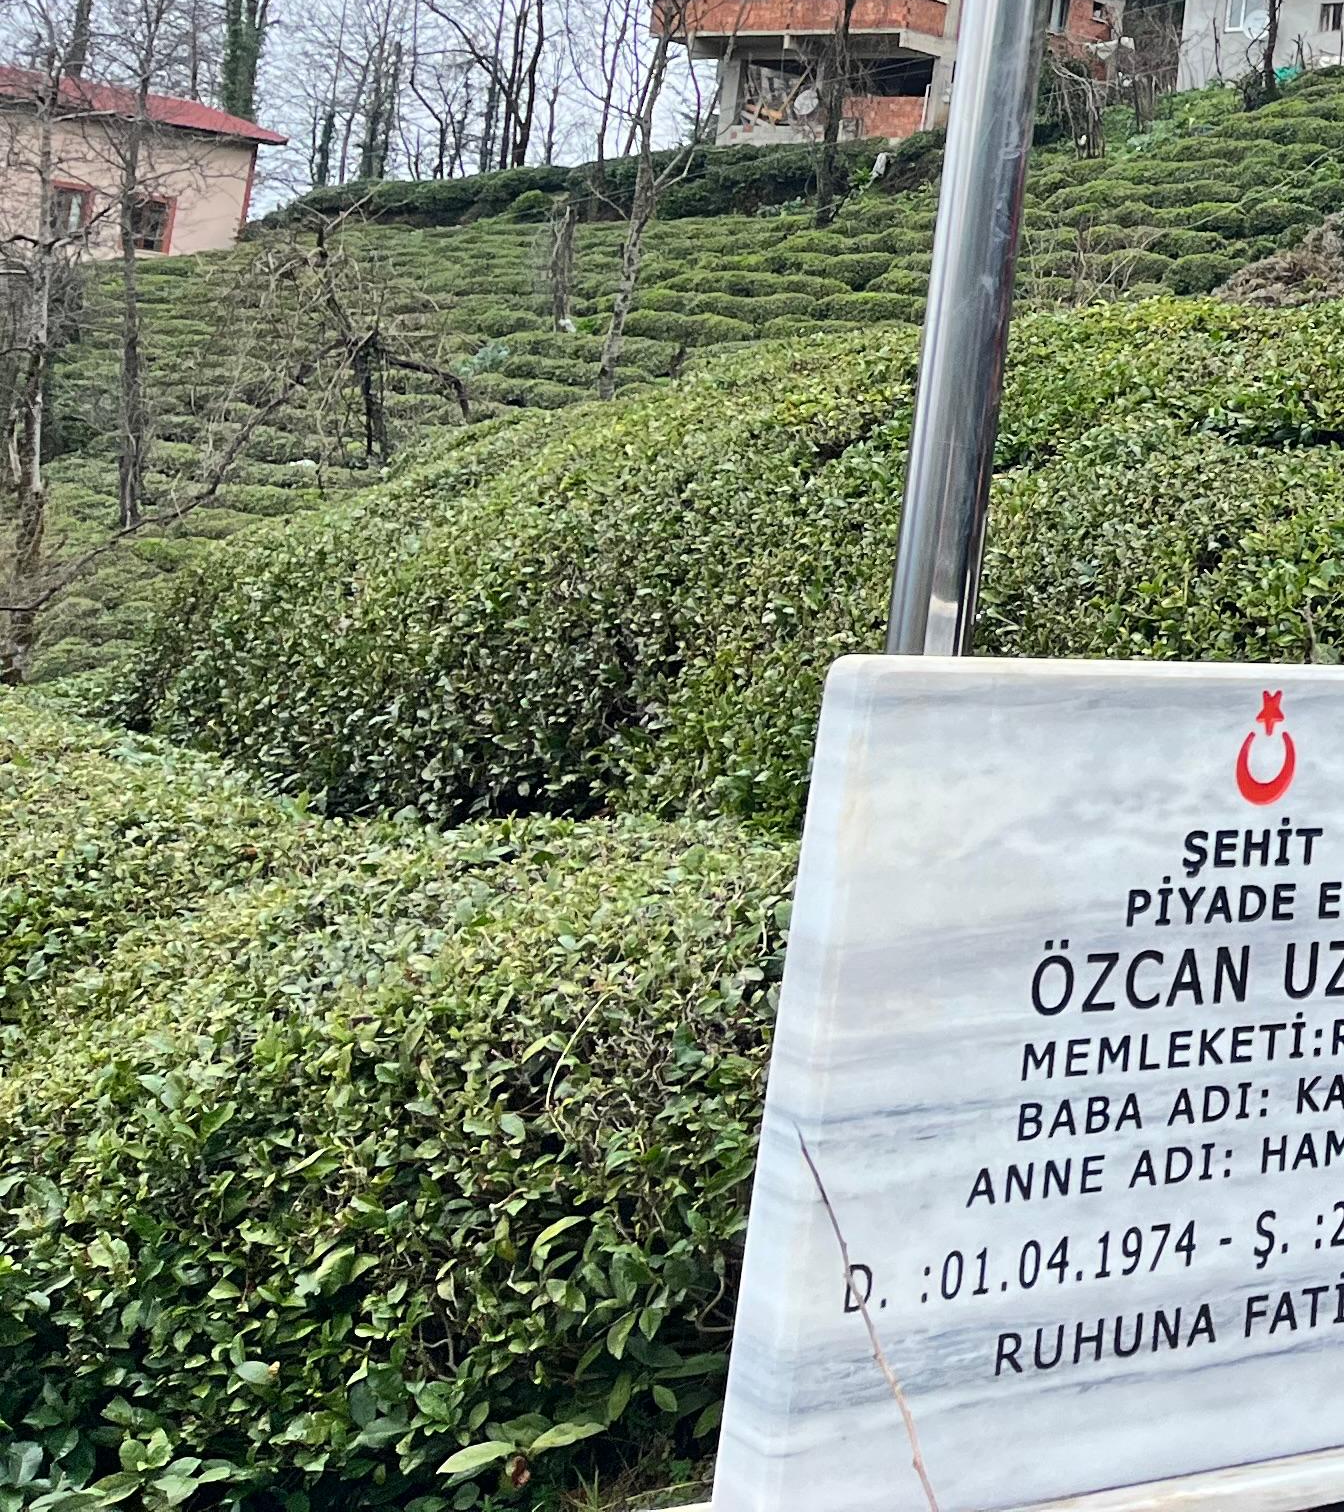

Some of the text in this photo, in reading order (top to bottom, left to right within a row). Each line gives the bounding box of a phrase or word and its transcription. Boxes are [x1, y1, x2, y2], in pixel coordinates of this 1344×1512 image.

[1182, 817, 1324, 878] ŞEHİT
[1126, 875, 1297, 928] PİYADE
[1031, 939, 1250, 1016] ÖZCAN
[1017, 1092, 1143, 1142] BABA
[1167, 1081, 1270, 1127] ADI:
[965, 1154, 1106, 1208] ANNE
[1127, 1142, 1233, 1189] ADI:
[843, 1263, 887, 1313] D.
[1252, 1209, 1288, 1270] Ş.
[994, 1303, 1216, 1377] RUHUNA
